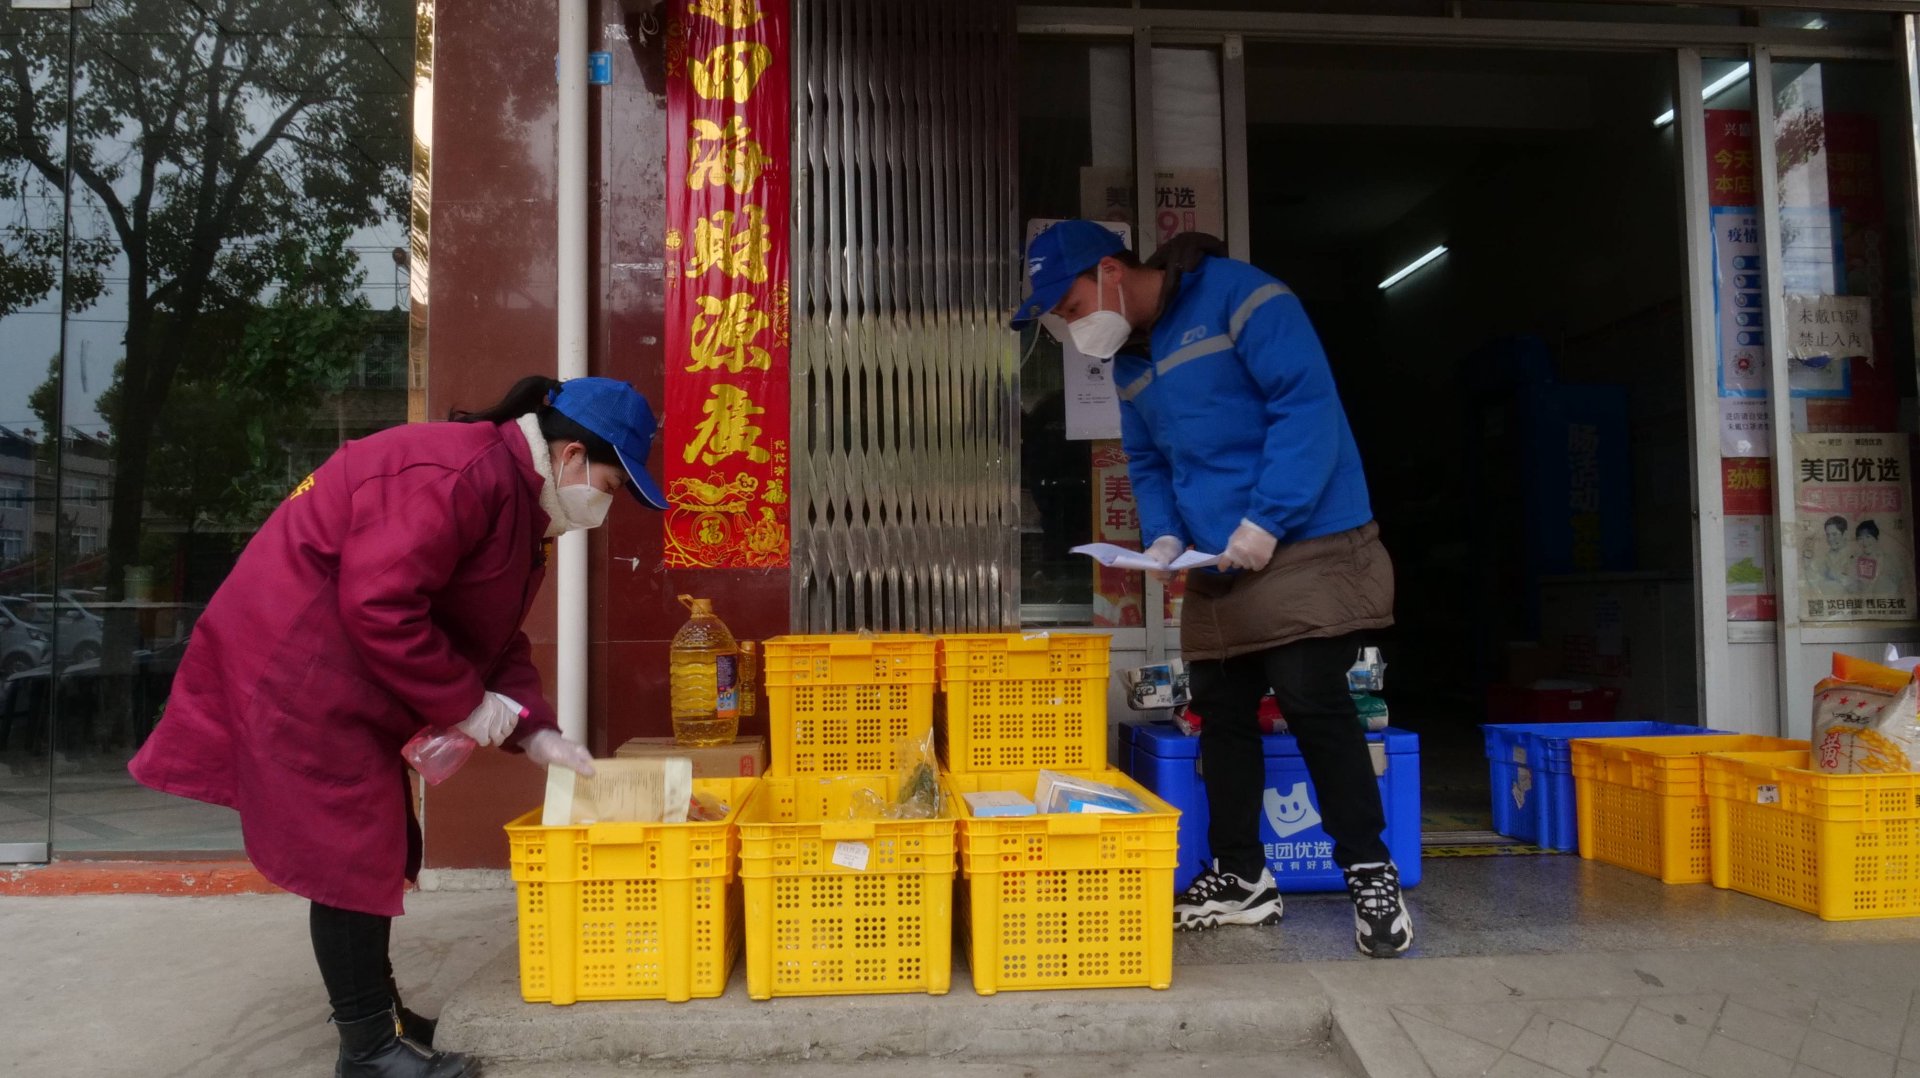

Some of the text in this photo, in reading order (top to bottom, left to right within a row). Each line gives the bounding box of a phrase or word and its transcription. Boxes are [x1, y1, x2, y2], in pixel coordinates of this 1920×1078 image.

[1799, 308, 1859, 326] 未戴口罩
[1801, 457, 1900, 483] 美团优选
[698, 519, 723, 545] 福
